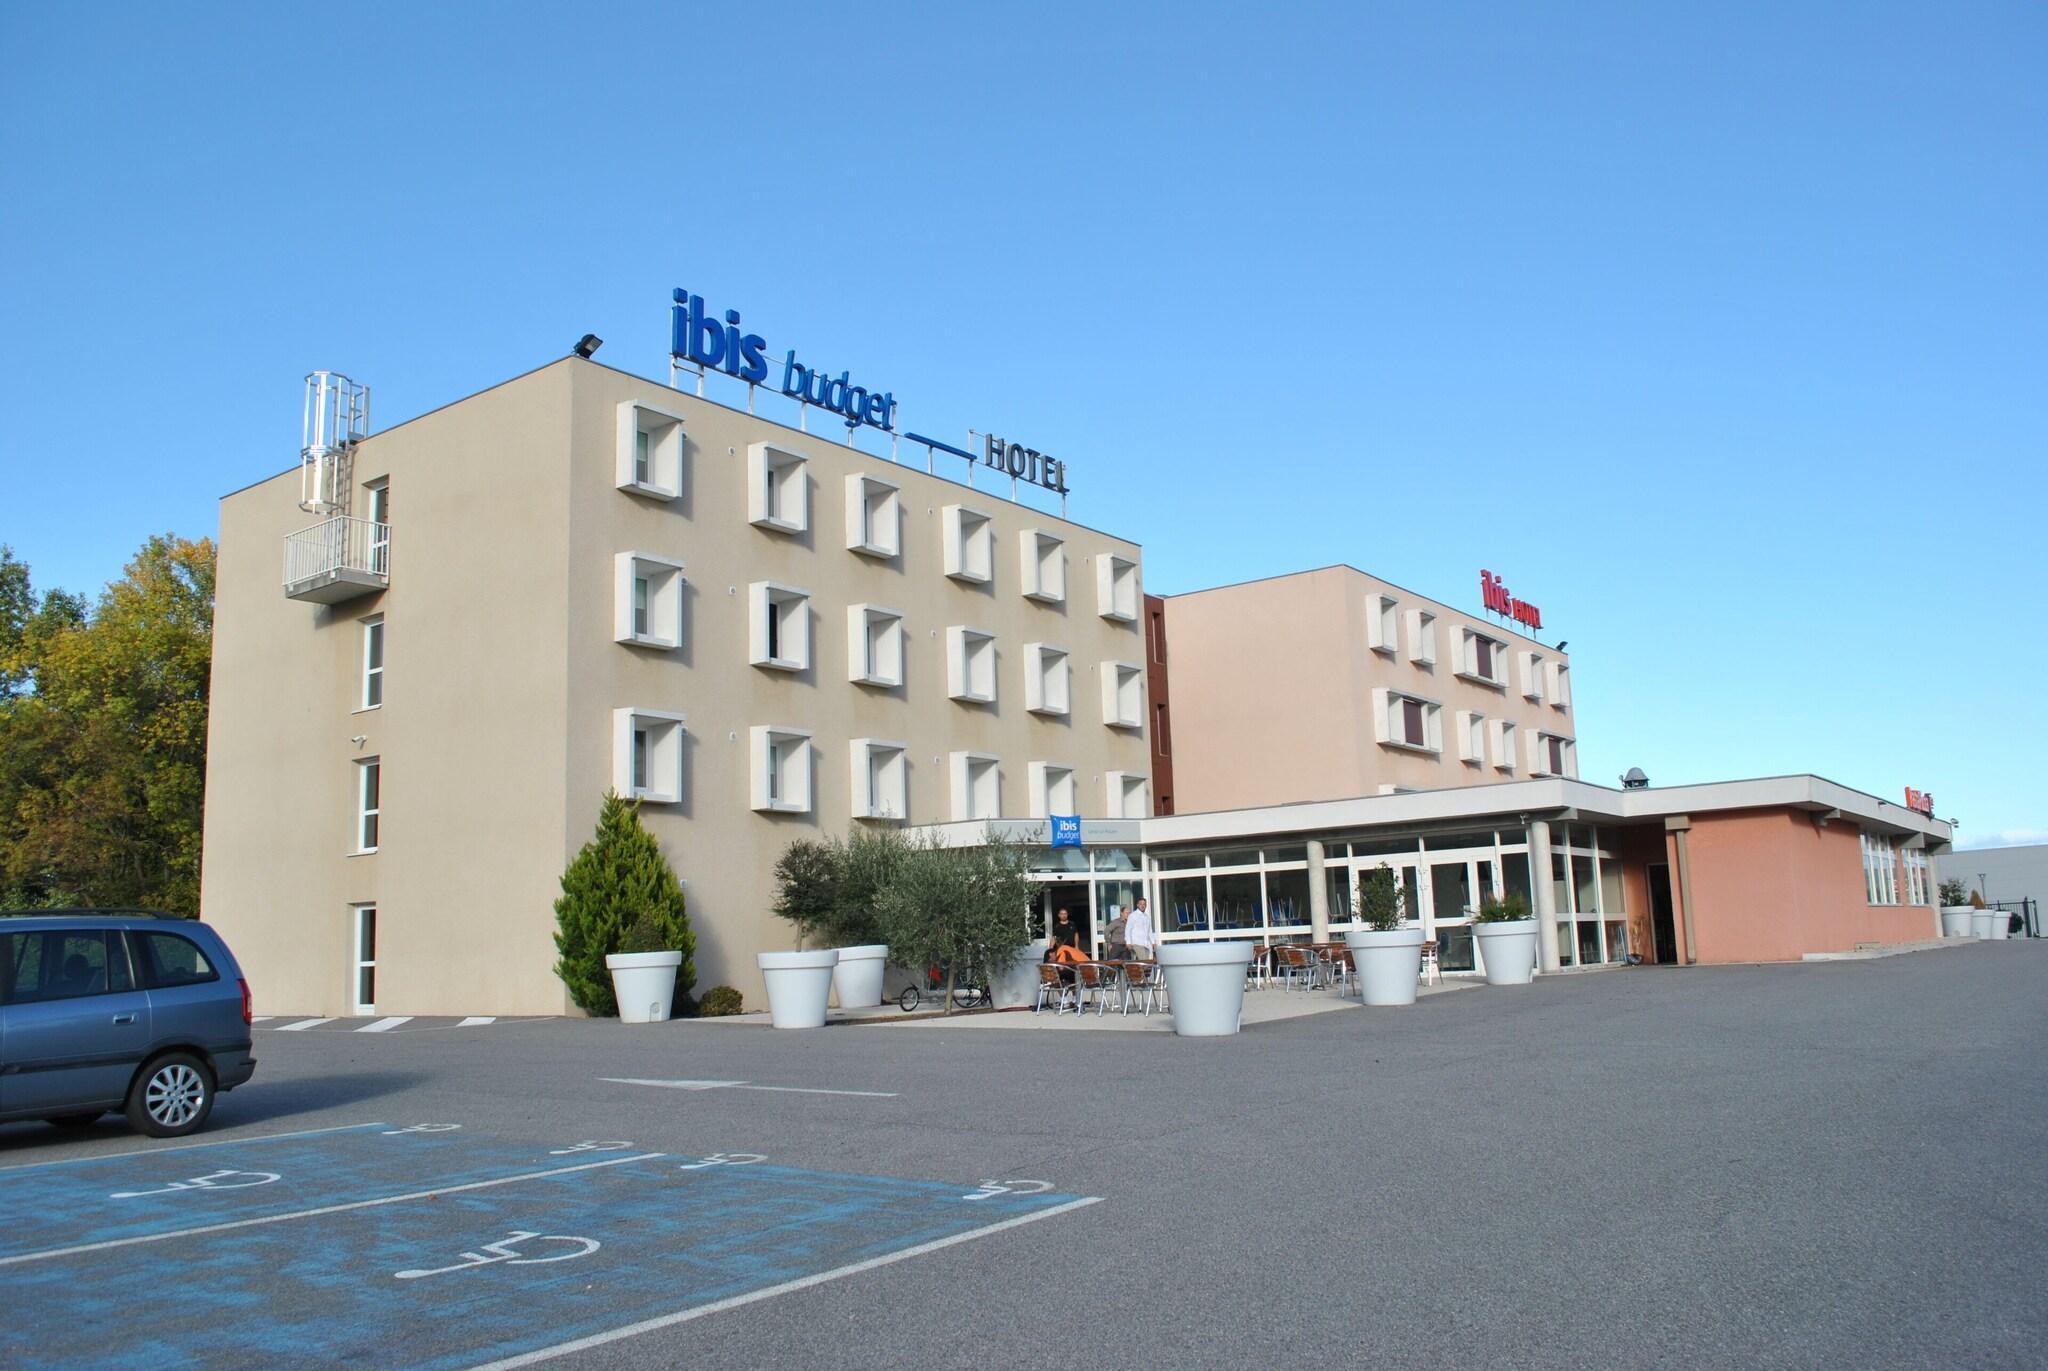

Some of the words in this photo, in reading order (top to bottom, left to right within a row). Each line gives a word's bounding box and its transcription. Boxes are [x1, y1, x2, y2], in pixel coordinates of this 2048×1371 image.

[672, 287, 768, 383] ibis
[782, 350, 897, 430] budget
[985, 433, 1069, 494] HOTEL
[1060, 820, 1077, 831] ibis
[1057, 831, 1080, 840] budget
